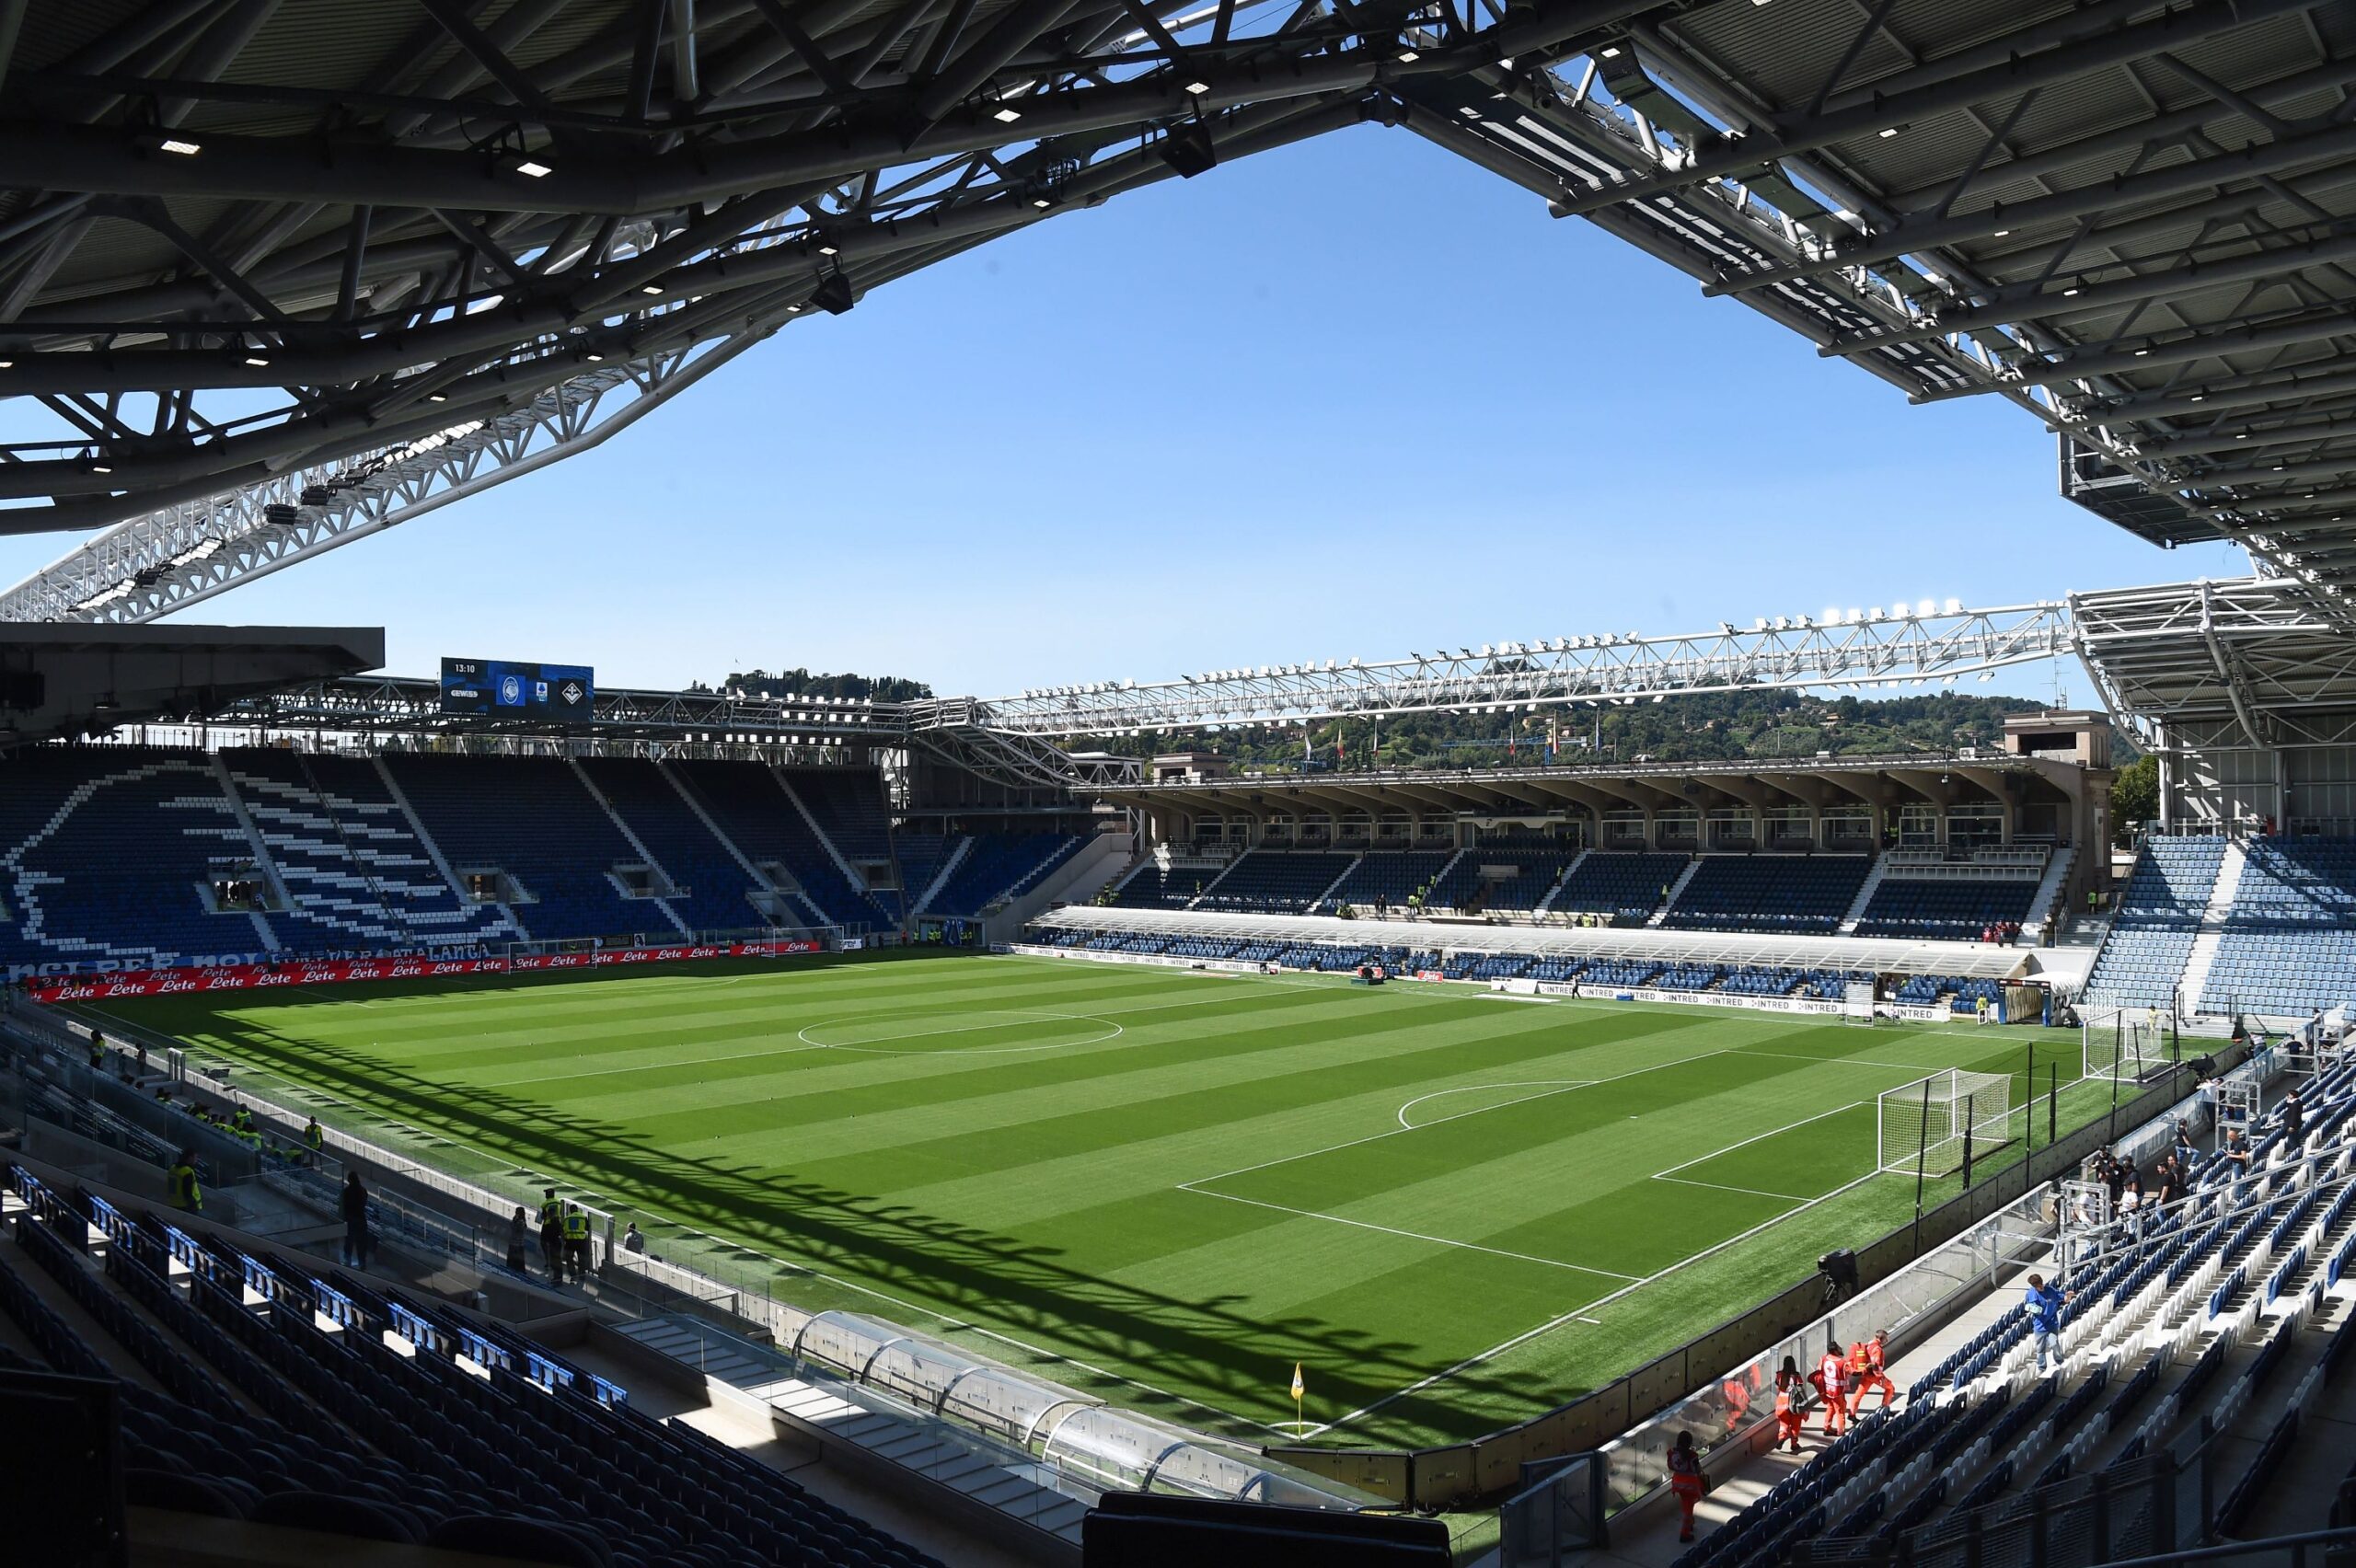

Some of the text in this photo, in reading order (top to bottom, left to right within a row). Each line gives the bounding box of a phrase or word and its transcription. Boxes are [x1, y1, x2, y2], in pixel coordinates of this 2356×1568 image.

[455, 663, 476, 674] 13:10
[55, 986, 95, 1000] Lete
[105, 983, 145, 997] Lete
[156, 979, 196, 993] Lete
[205, 976, 244, 989] Lete
[254, 974, 292, 986] Lete
[301, 970, 337, 983] Lete
[346, 967, 380, 980] Lete
[387, 964, 422, 977] Lete
[431, 963, 463, 974] Lete
[548, 955, 577, 967] Lete
[619, 951, 648, 963] Lete
[655, 948, 682, 960] Lete
[688, 946, 715, 958] Lete
[785, 942, 810, 952] Lete
[1587, 988, 1614, 997] INTRED
[1669, 994, 1699, 1003] INTRED
[1713, 997, 1743, 1006] INTRED
[1758, 999, 1789, 1009] INTRED
[1805, 1003, 1837, 1012] INTRED
[1898, 1009, 1933, 1019] INTRED
